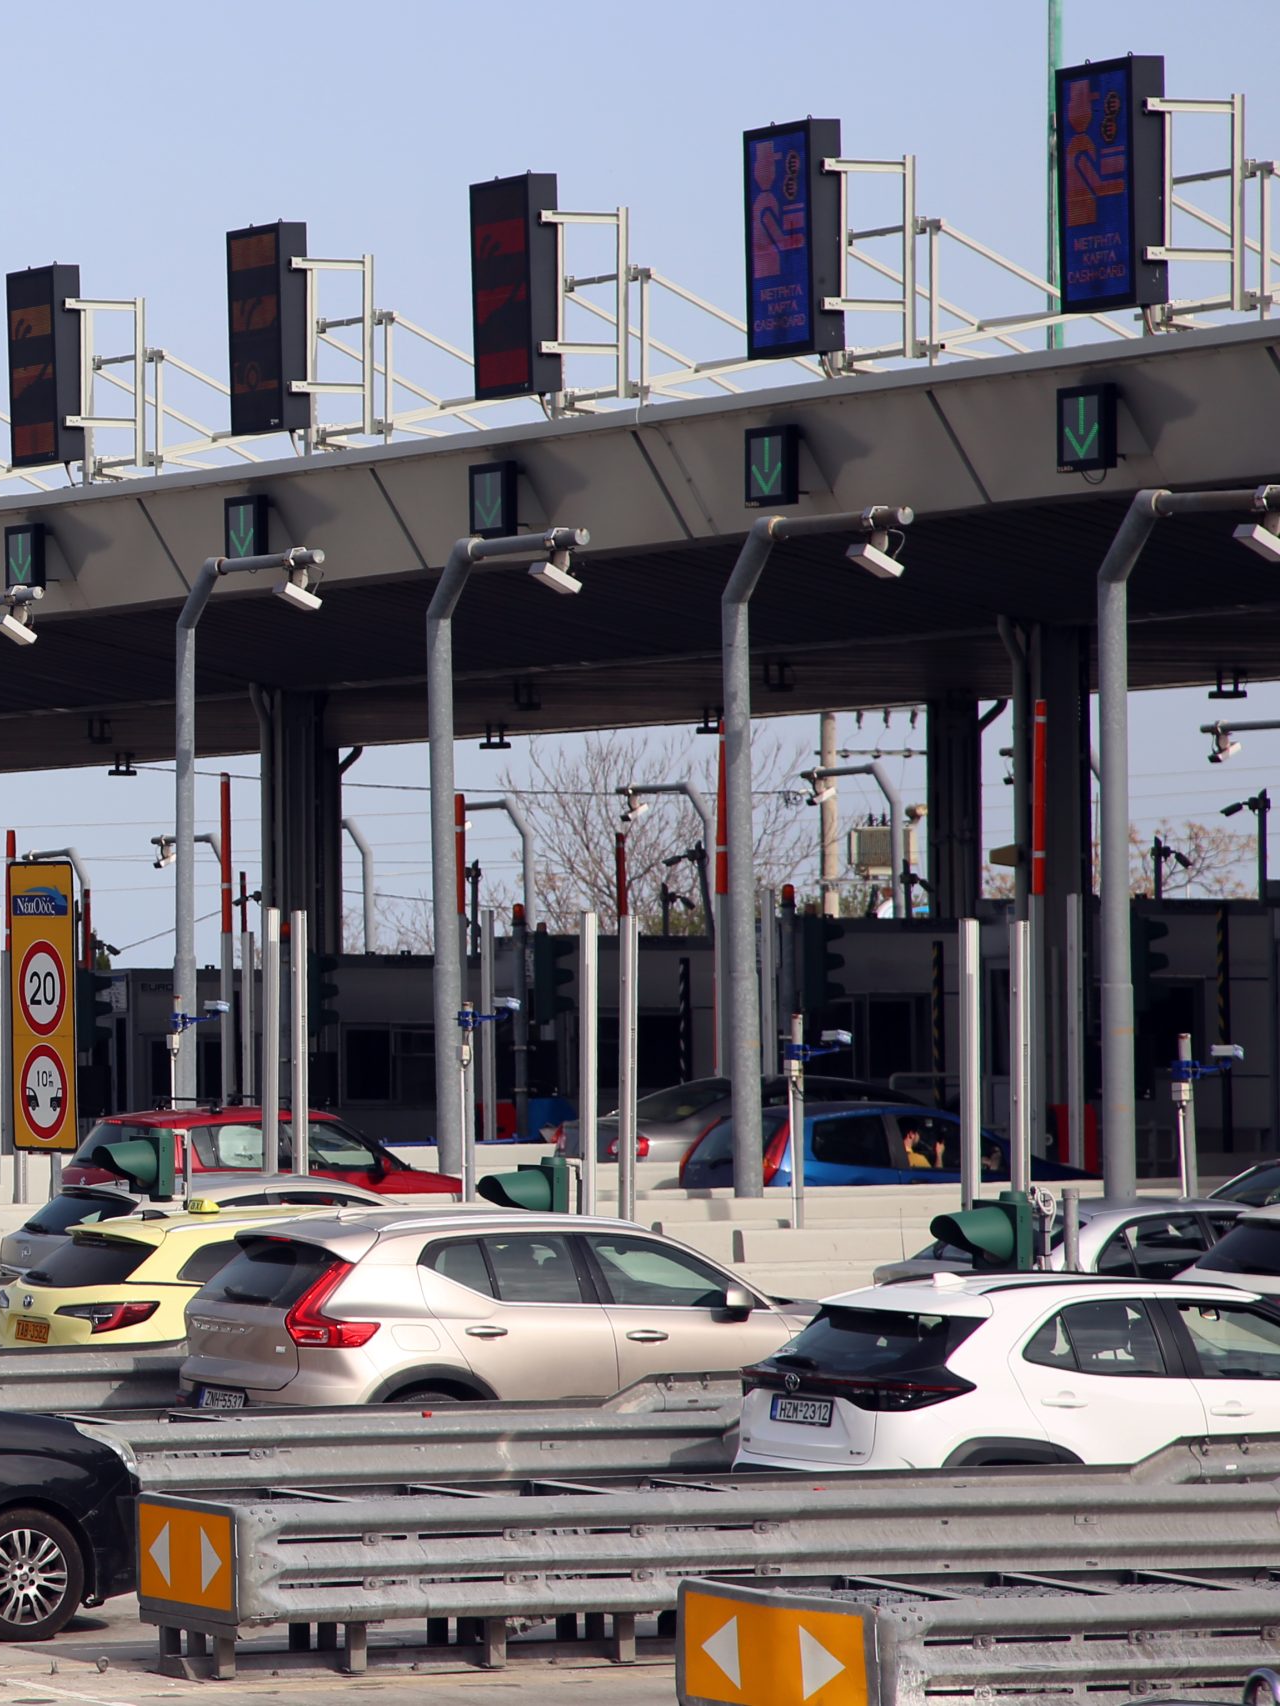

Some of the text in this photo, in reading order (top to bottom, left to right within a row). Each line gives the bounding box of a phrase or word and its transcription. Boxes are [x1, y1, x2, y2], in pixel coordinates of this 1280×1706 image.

[30, 971, 55, 1006] 20
[37, 1070, 48, 1087] 10
[779, 1401, 830, 1422] HZM-2312
